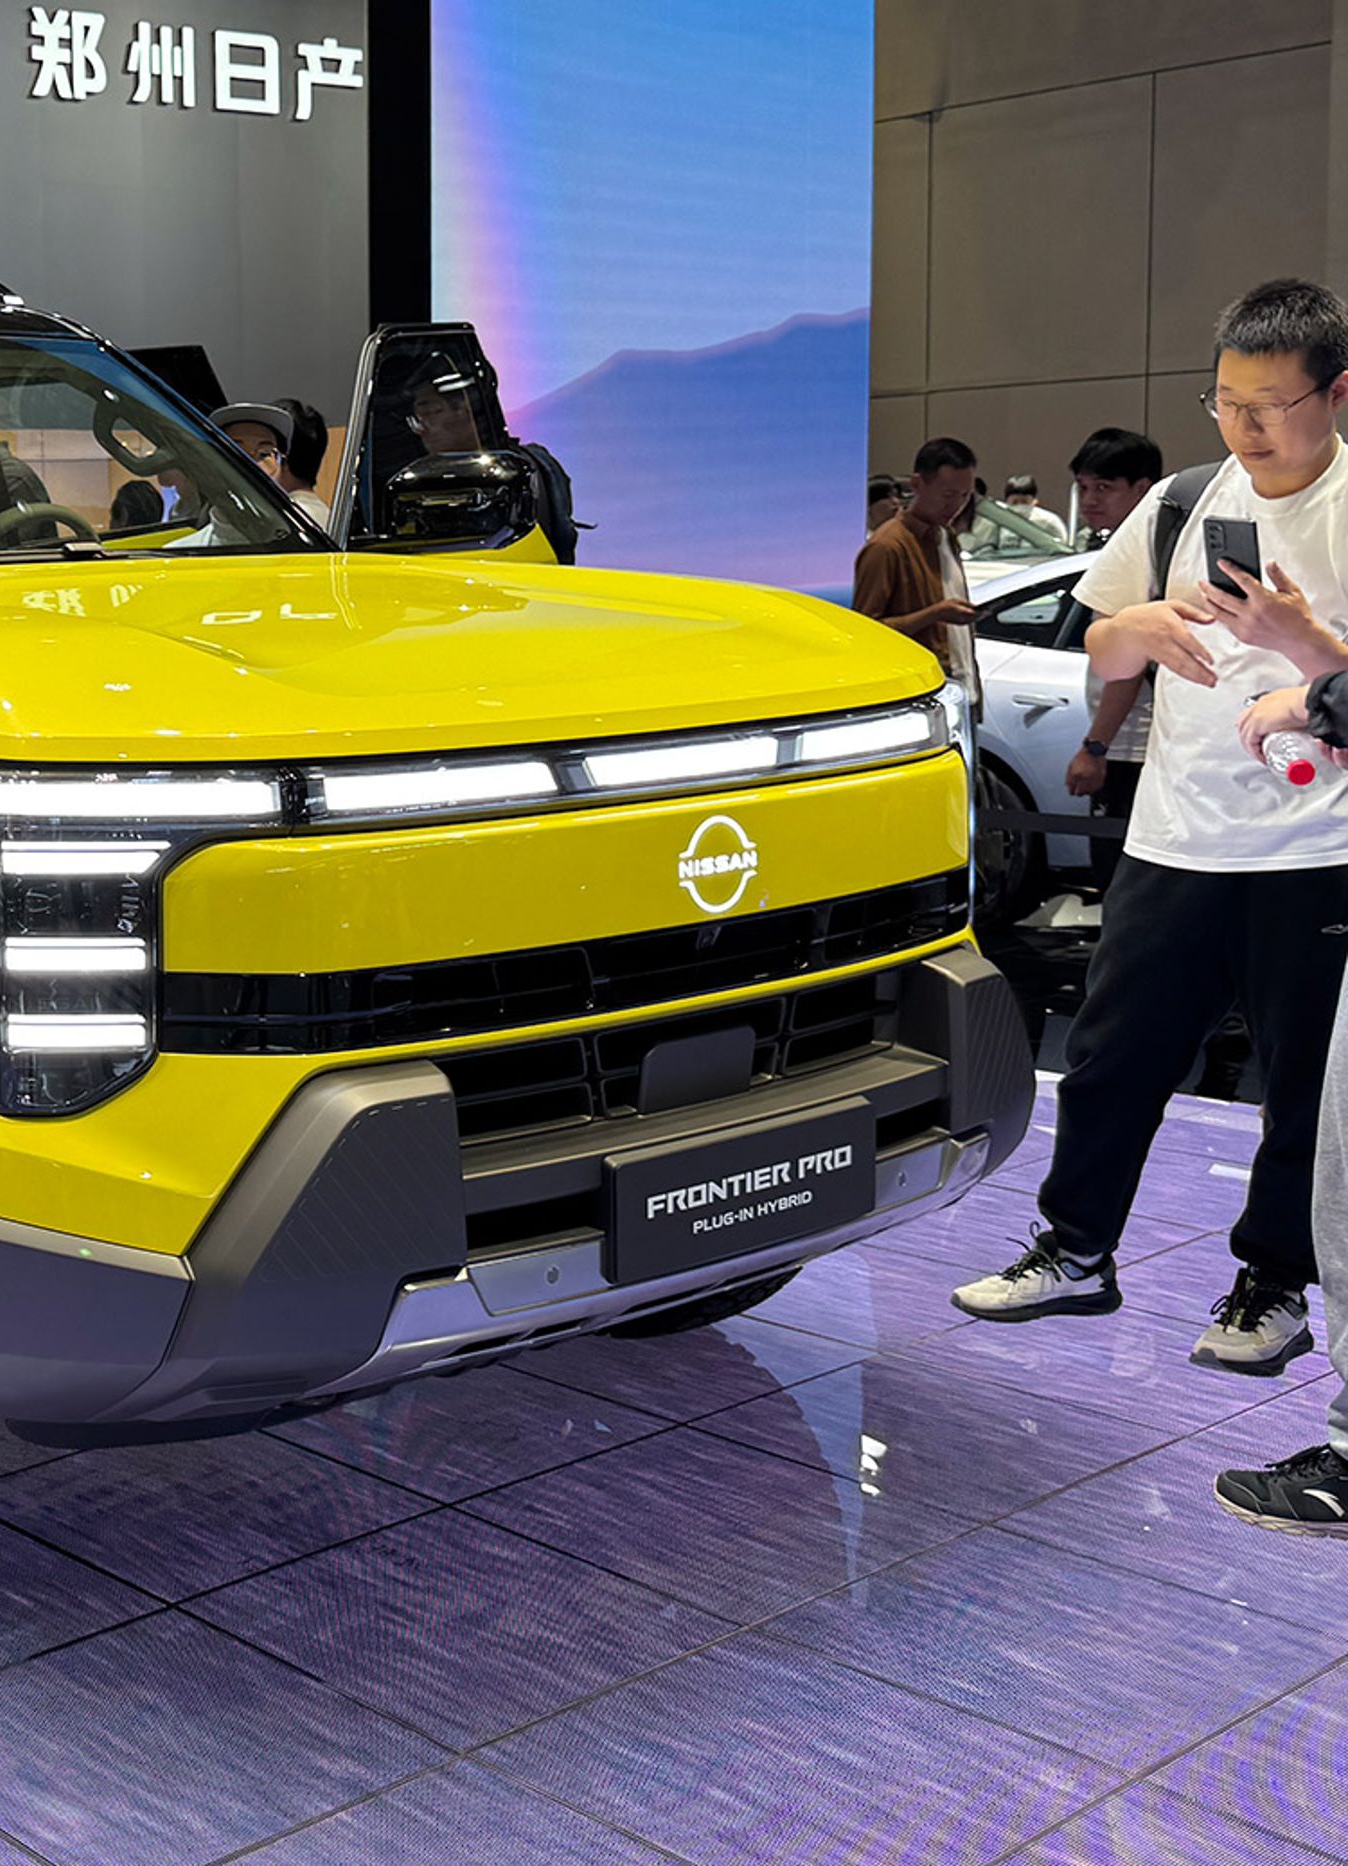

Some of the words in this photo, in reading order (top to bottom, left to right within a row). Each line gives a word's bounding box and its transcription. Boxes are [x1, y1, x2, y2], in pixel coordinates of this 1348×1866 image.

[27, 7, 364, 121] 郑州日产
[678, 850, 758, 879] NISSAN
[647, 1161, 791, 1220] FRONTIER
[798, 1144, 852, 1179] PRO
[693, 1206, 754, 1234] PLUG-IN
[757, 1190, 813, 1217] HYBRID
